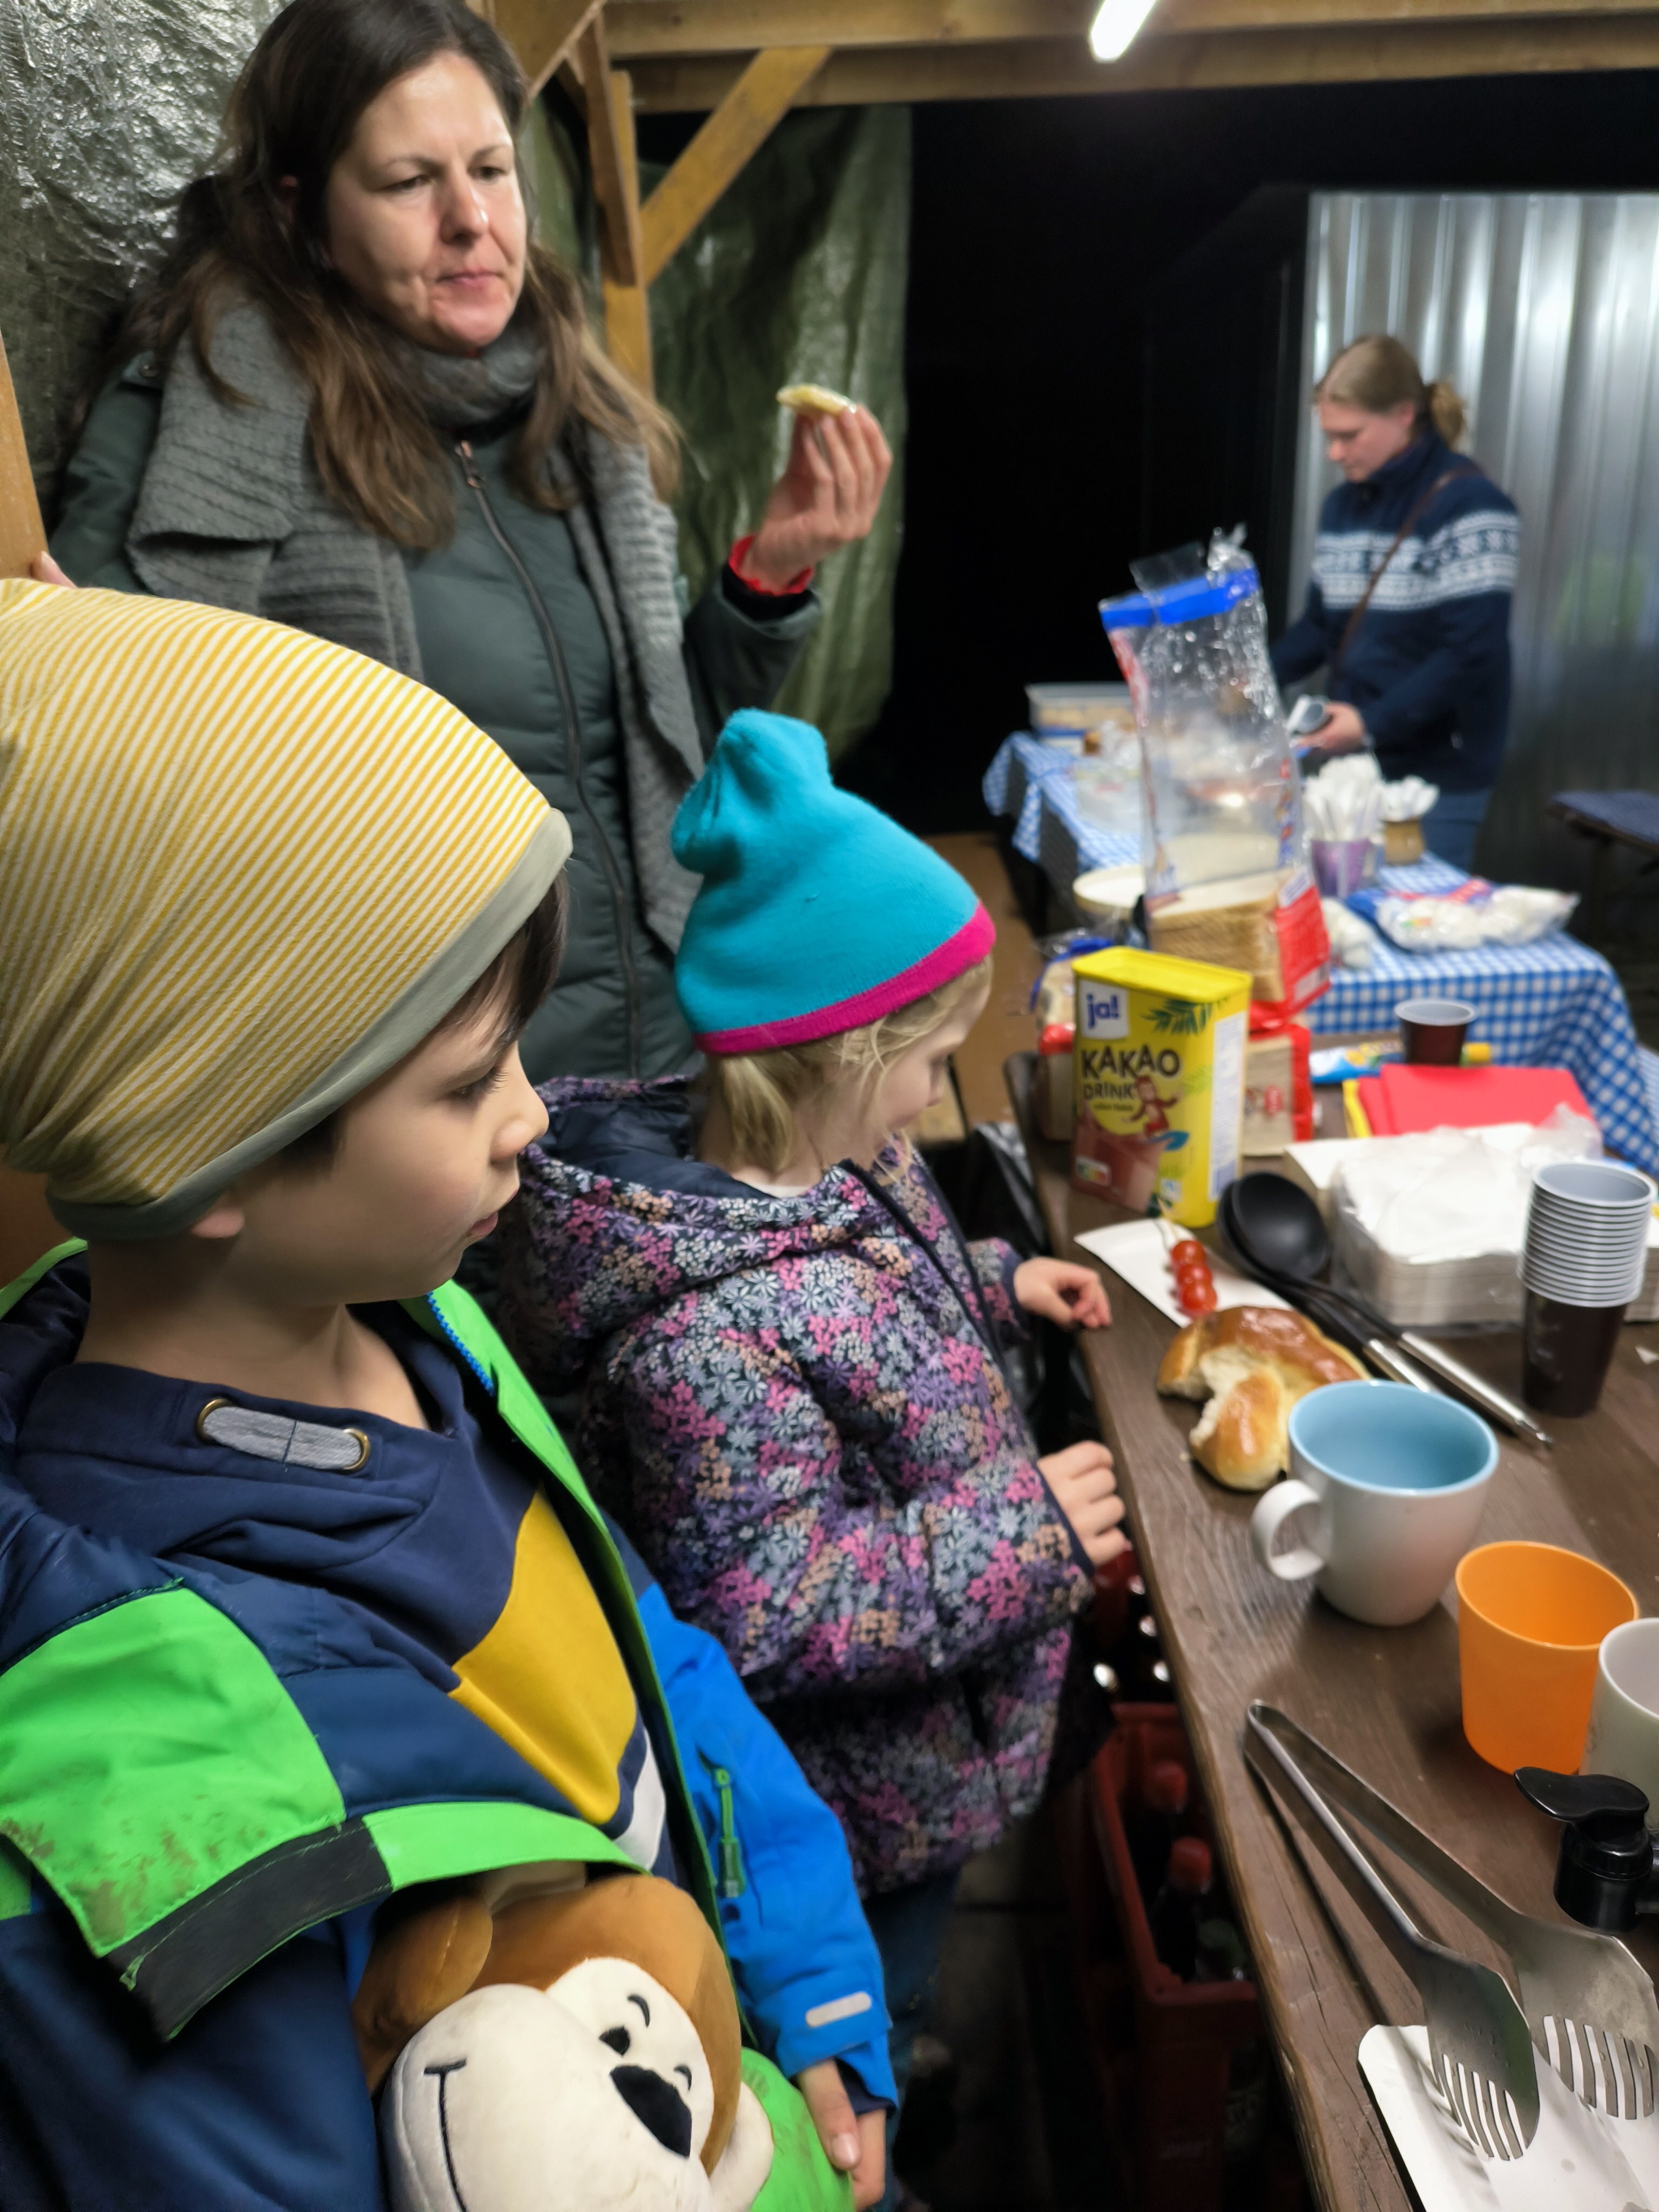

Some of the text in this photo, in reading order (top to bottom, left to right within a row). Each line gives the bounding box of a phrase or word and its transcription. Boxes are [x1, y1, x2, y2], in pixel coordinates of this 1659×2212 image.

[1086, 993, 1120, 1029] ja!
[1081, 1045, 1181, 1078] KAKAO
[1082, 1081, 1135, 1100] DRINK
